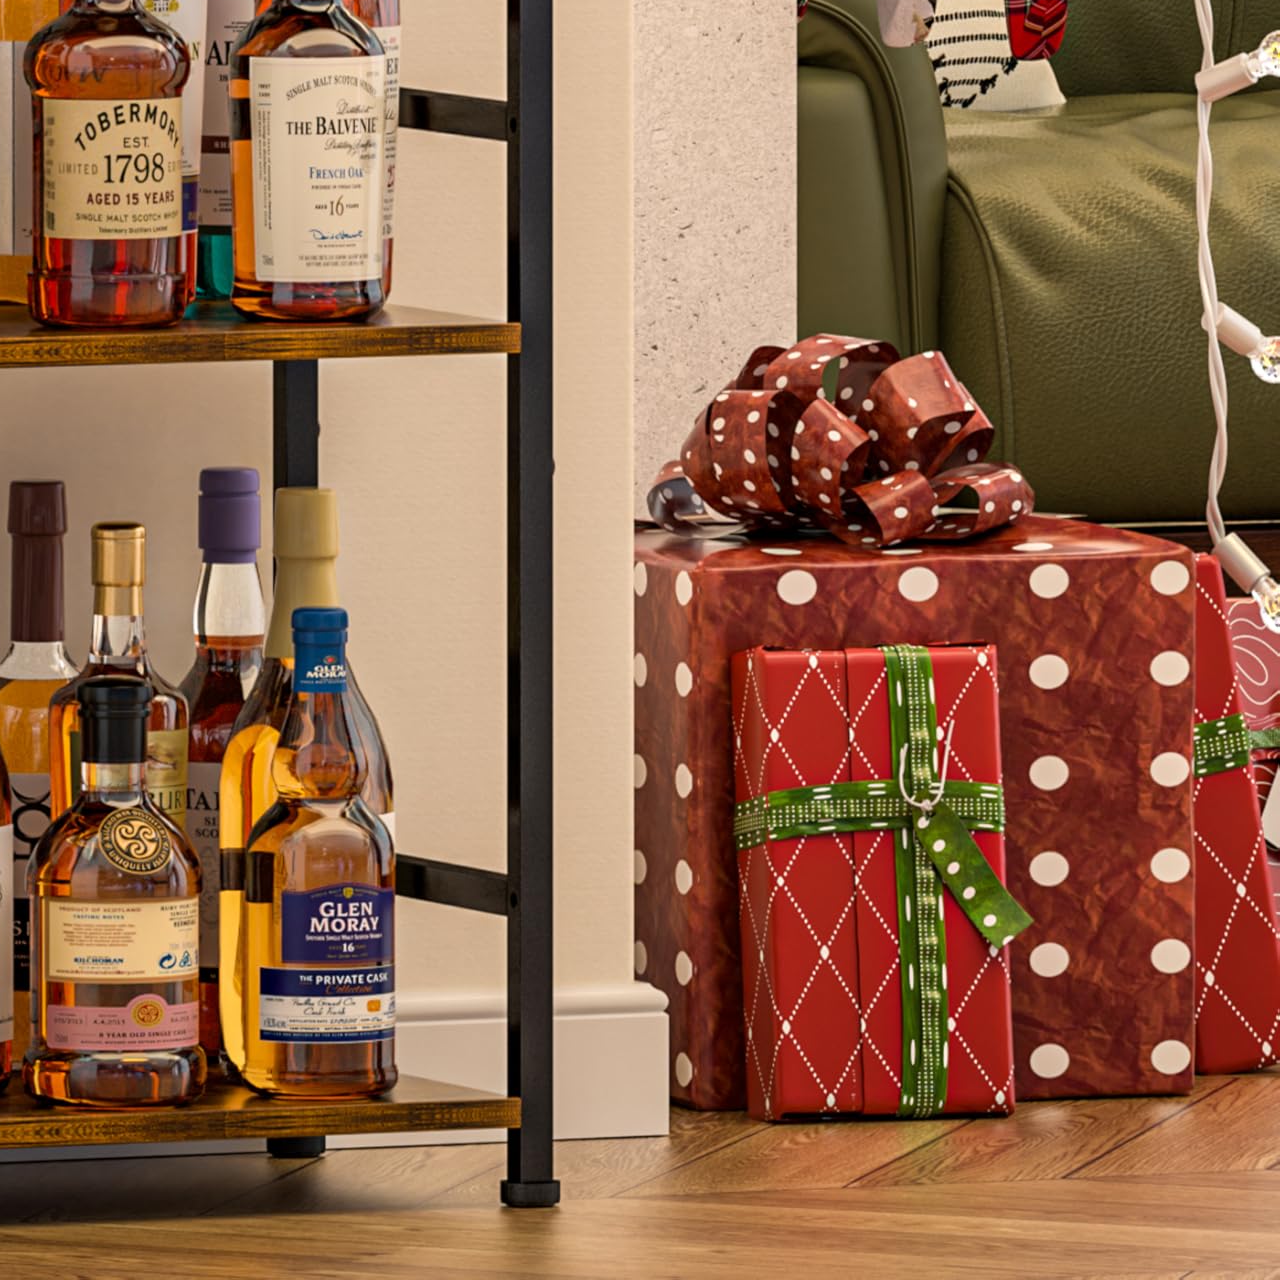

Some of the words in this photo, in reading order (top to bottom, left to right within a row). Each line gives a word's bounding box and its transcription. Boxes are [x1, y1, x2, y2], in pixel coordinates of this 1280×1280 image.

[313, 75, 332, 88] MALT
[74, 103, 180, 152] TOBERMORY
[286, 121, 312, 135] THE
[316, 116, 378, 135] BALVENIE
[58, 163, 98, 175] LIMITED
[103, 152, 165, 184] 1798
[309, 167, 345, 179] FRENCH
[348, 166, 364, 178] OAK
[86, 193, 120, 205] AGED
[126, 193, 139, 205] 15
[144, 190, 174, 204] YEARS
[329, 195, 344, 217] 16
[75, 213, 103, 222] SINGLE
[106, 214, 128, 222] MALT
[132, 213, 161, 222] SCOTCH
[314, 664, 344, 672] GLEN
[319, 901, 373, 917] GLEN
[310, 916, 379, 933] MORAY
[342, 942, 355, 953] 16
[315, 975, 364, 985] PRIVATE
[366, 972, 388, 983] CASK
